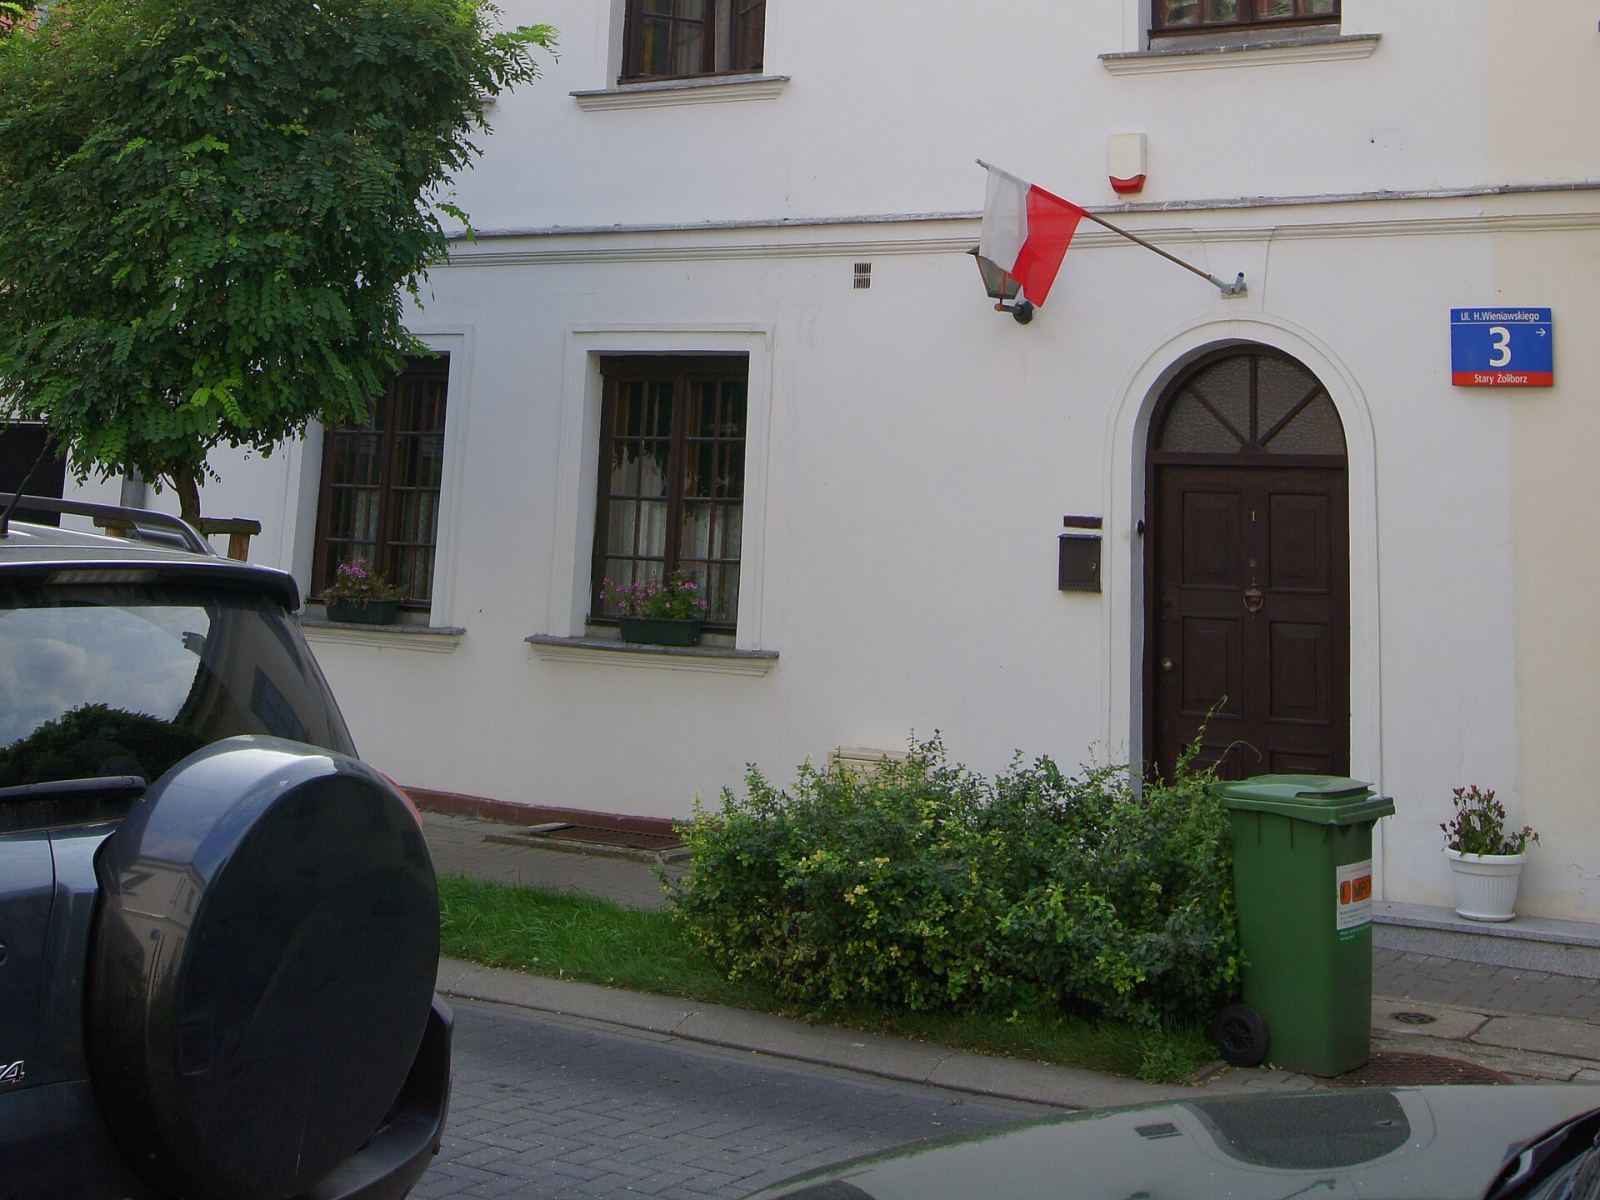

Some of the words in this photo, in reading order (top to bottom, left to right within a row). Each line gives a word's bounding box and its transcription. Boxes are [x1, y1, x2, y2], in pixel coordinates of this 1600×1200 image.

[1489, 326, 1512, 367] 3
[1474, 373, 1494, 385] Stary
[1497, 371, 1528, 384] Żoliborz
